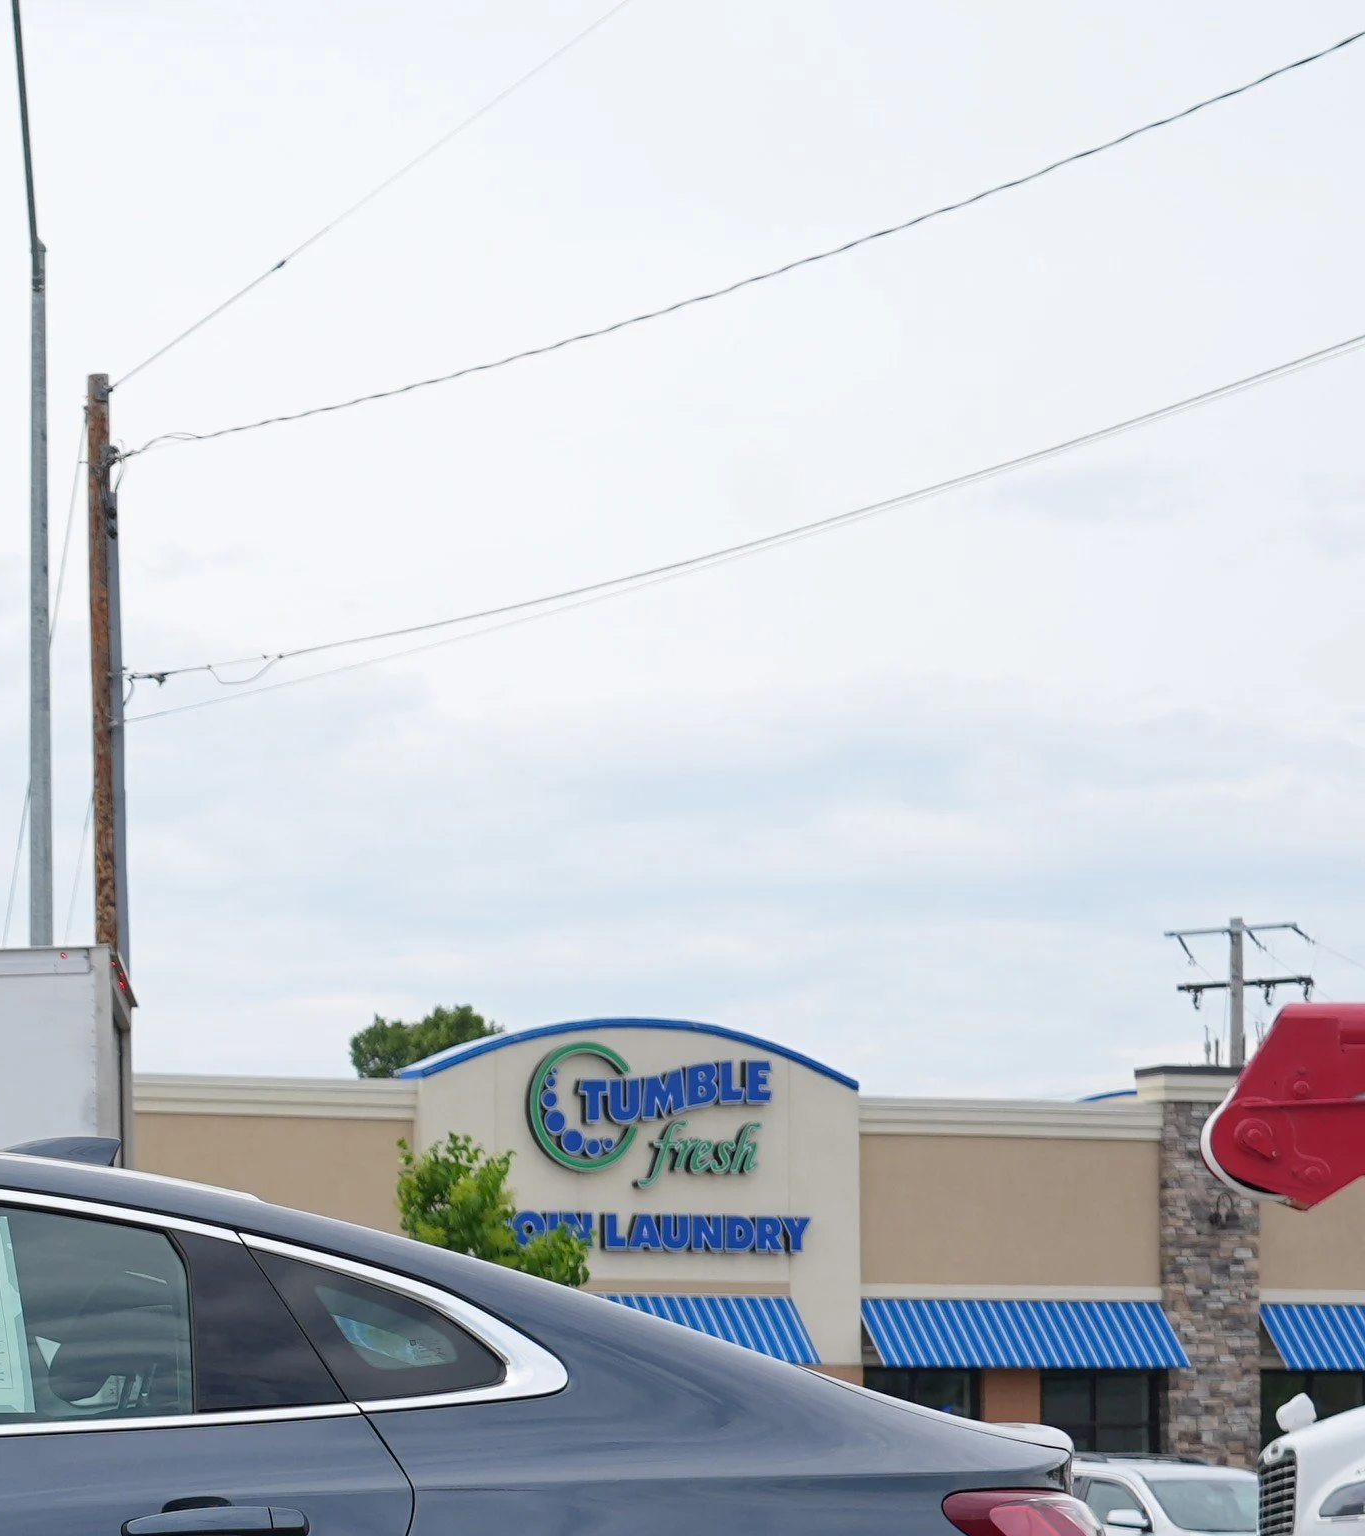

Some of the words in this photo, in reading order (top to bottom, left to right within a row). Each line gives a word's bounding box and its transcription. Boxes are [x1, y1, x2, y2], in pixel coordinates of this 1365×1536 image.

[578, 1059, 773, 1125] TUMBLE
[636, 1119, 763, 1190] fresh
[600, 1212, 811, 1254] LAUNDRY
